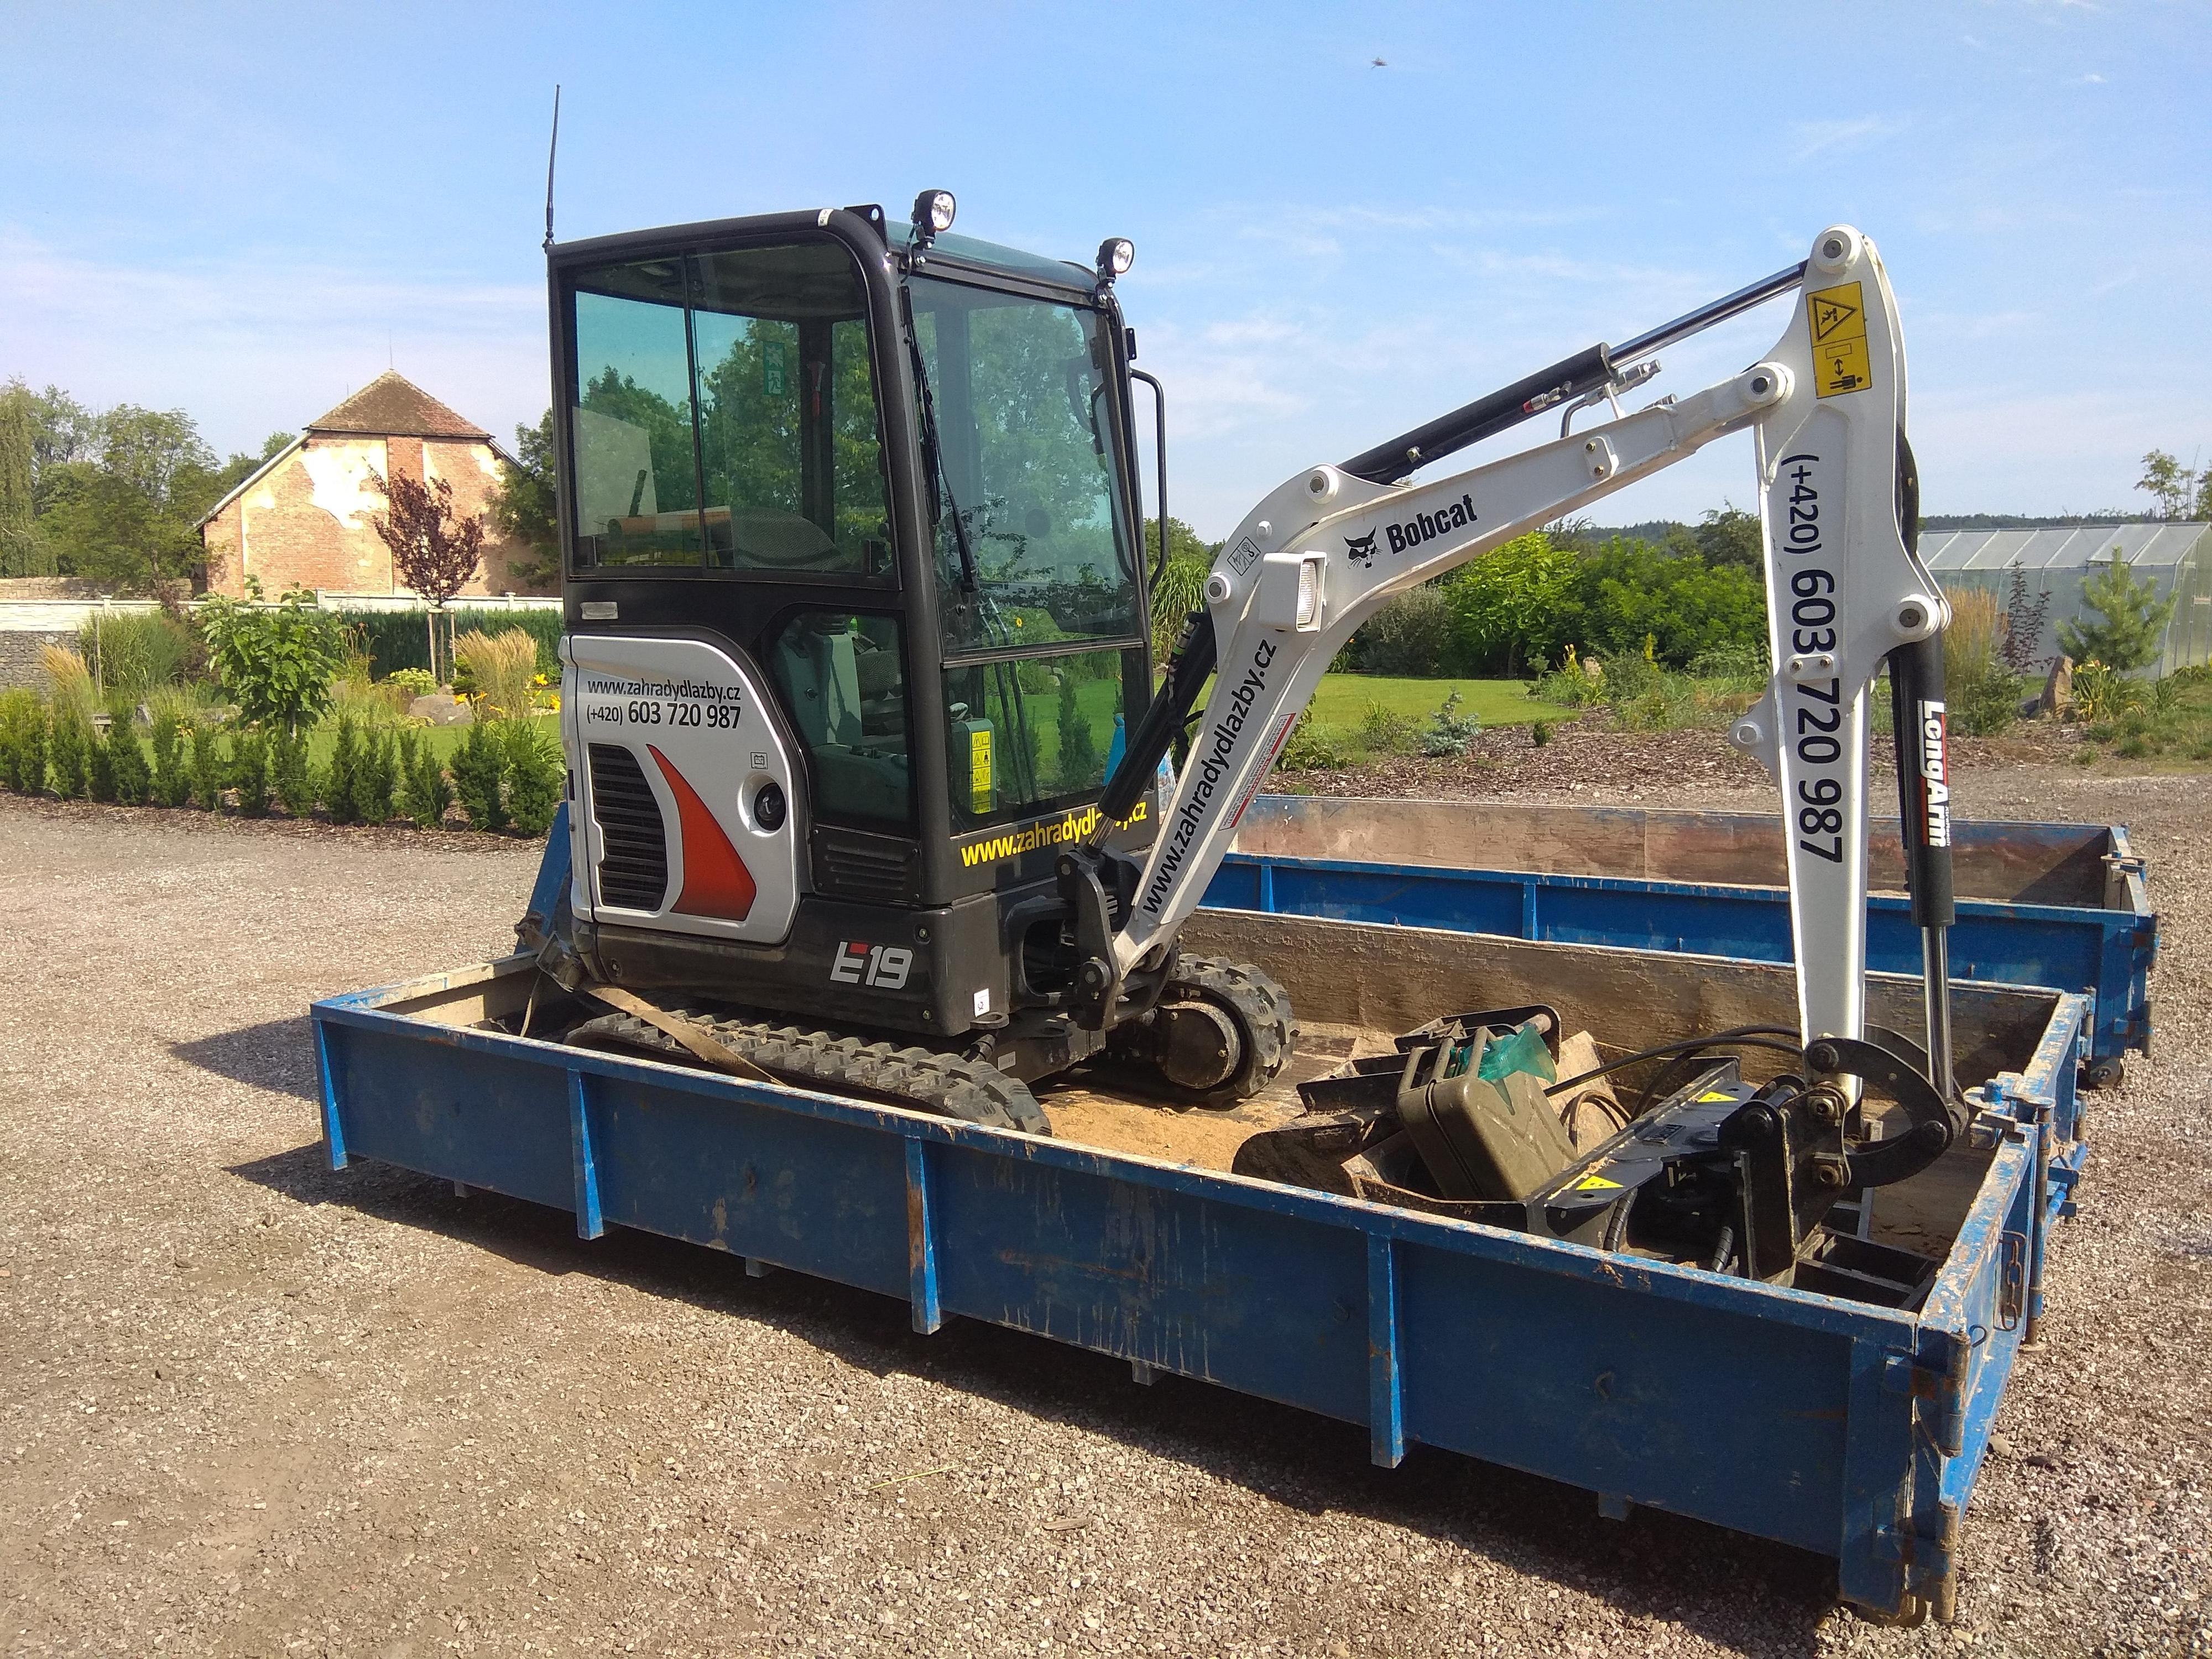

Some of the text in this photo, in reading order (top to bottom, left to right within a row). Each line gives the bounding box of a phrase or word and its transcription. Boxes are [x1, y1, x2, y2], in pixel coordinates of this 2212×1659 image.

[1385, 494, 1478, 555] Bobcat
[1781, 454, 1843, 863] (+420) 603 720 987
[587, 678, 741, 704] www.zahradydlazby.cz
[587, 701, 741, 729] (+420) 603 720 987
[1142, 639, 1277, 916] www.zahradydlazby.cz
[1921, 700, 1949, 848] LongArm
[961, 802, 1147, 867] www.zahradydl.cz
[830, 941, 913, 989] E19
